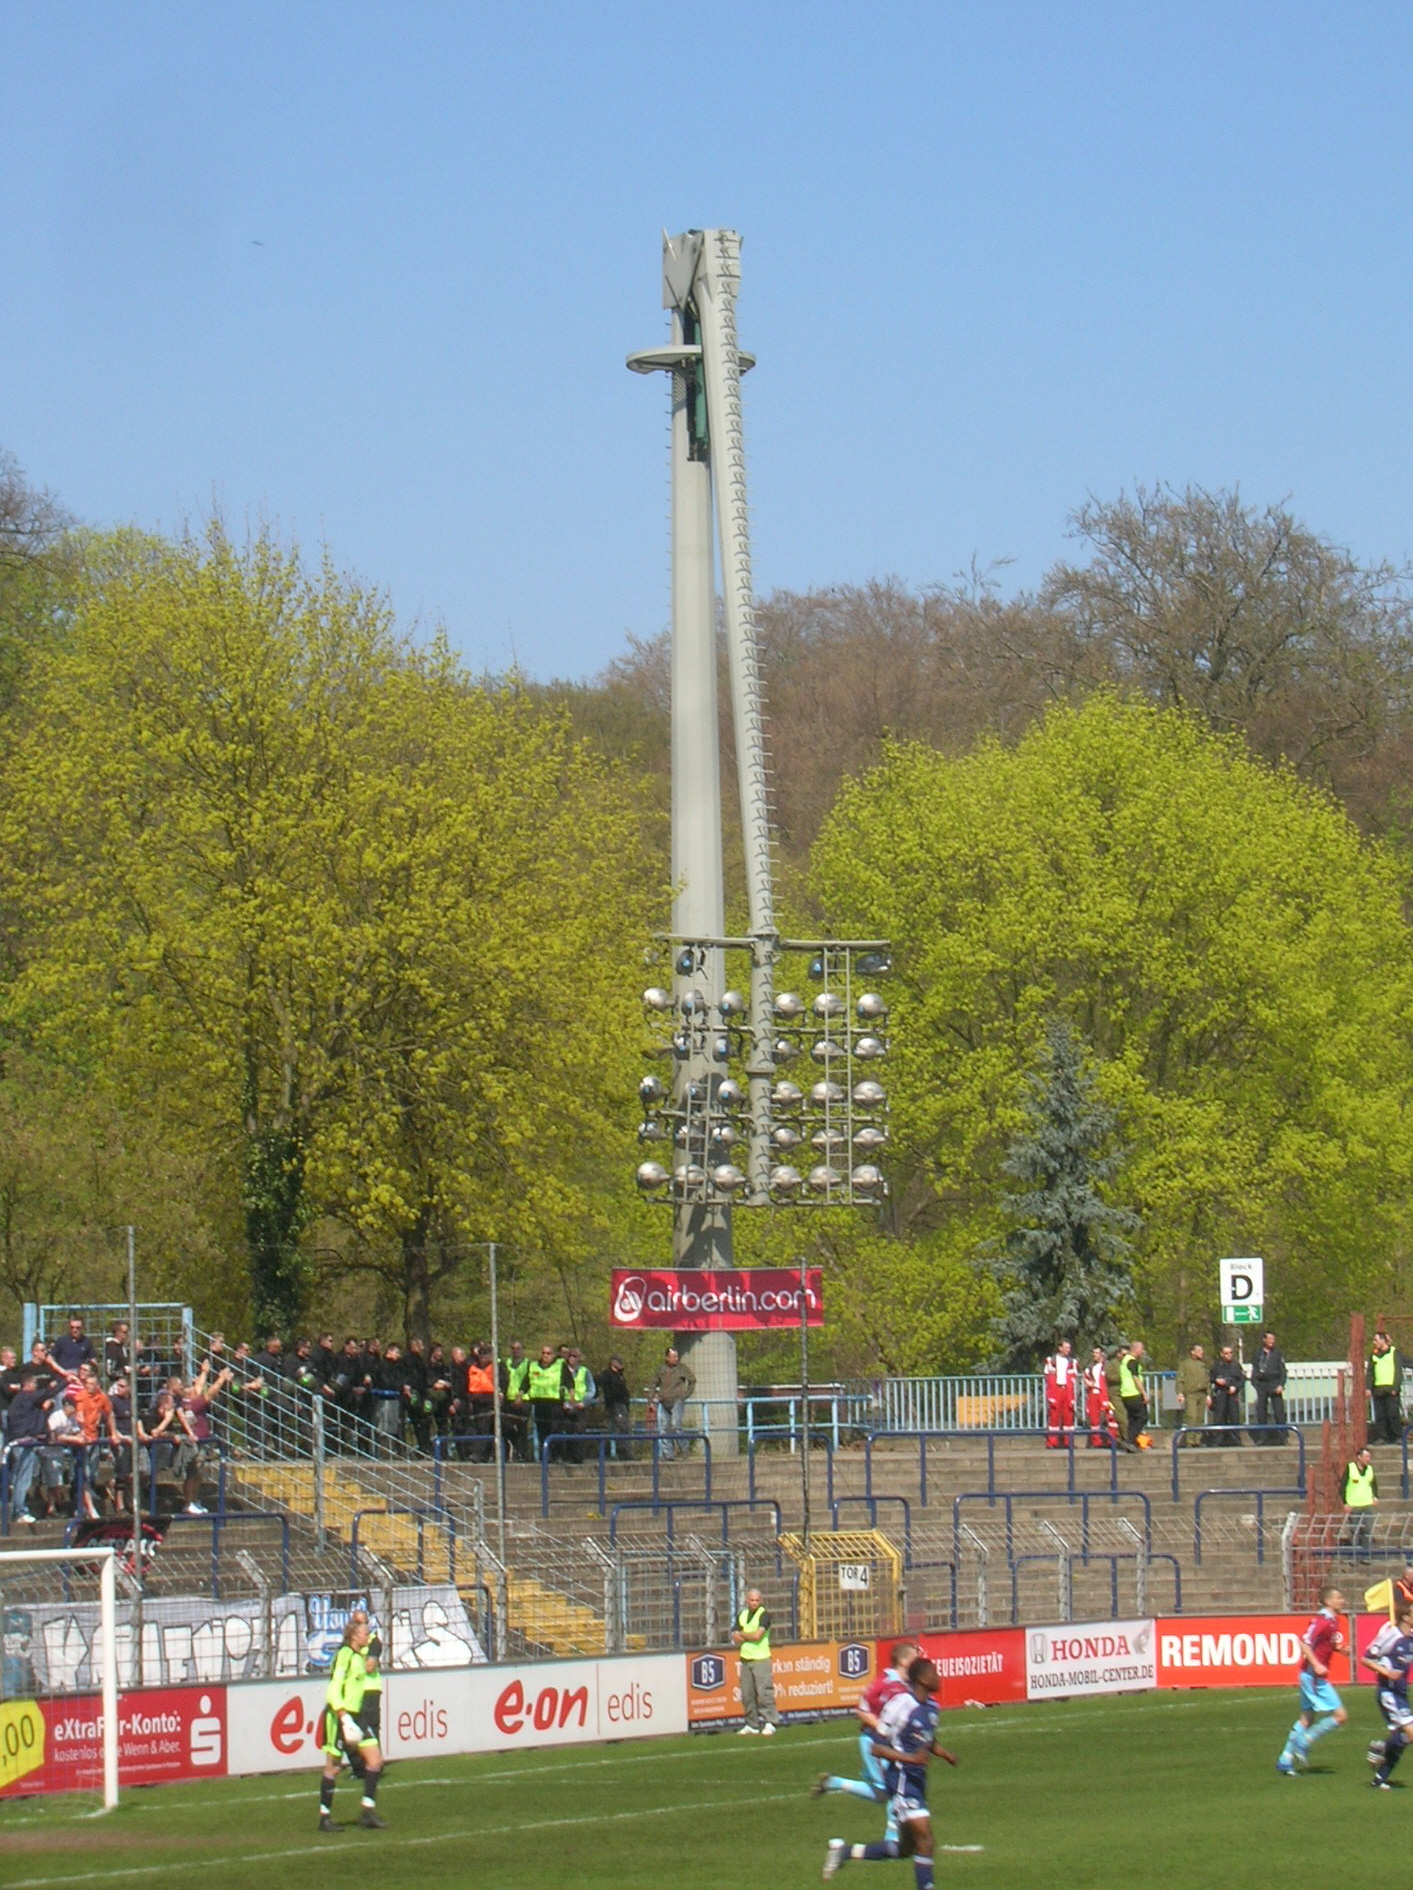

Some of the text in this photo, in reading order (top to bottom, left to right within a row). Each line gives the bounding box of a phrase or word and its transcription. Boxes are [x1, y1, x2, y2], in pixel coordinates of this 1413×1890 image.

[648, 1284, 816, 1312] airberlin.com
[1230, 1274, 1253, 1300] D
[860, 1567, 868, 1585] 4
[847, 1649, 860, 1672] B5
[1051, 1635, 1131, 1661] HONDA
[1161, 1633, 1301, 1667] REMOND
[701, 1660, 715, 1684] B5
[795, 1655, 831, 1674] ständig
[933, 1651, 1003, 1677] EUESOZIETÄT
[607, 1682, 653, 1722] edis
[398, 1699, 448, 1741] edis
